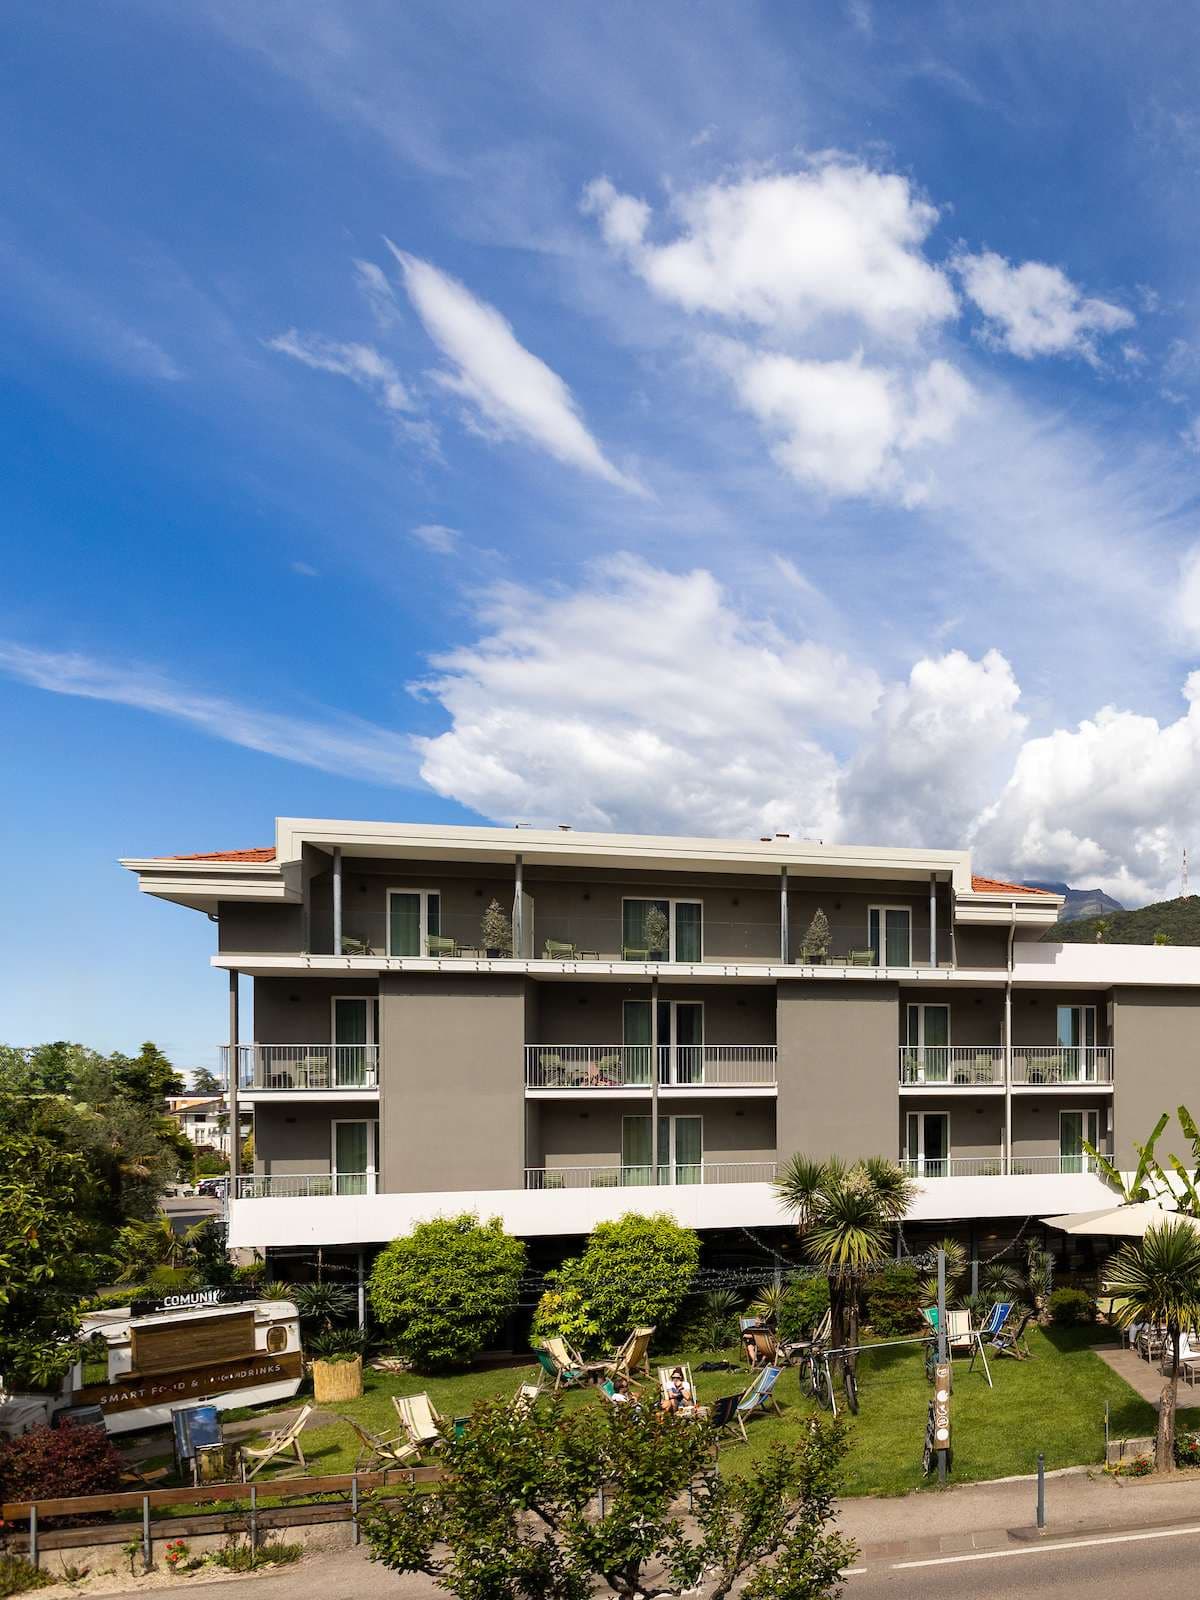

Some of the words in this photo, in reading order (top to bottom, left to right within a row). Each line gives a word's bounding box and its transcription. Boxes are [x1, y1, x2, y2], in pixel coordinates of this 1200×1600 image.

[100, 1388, 146, 1405] SMART
[191, 1379, 199, 1388] &
[240, 1364, 281, 1378] DRINKS
